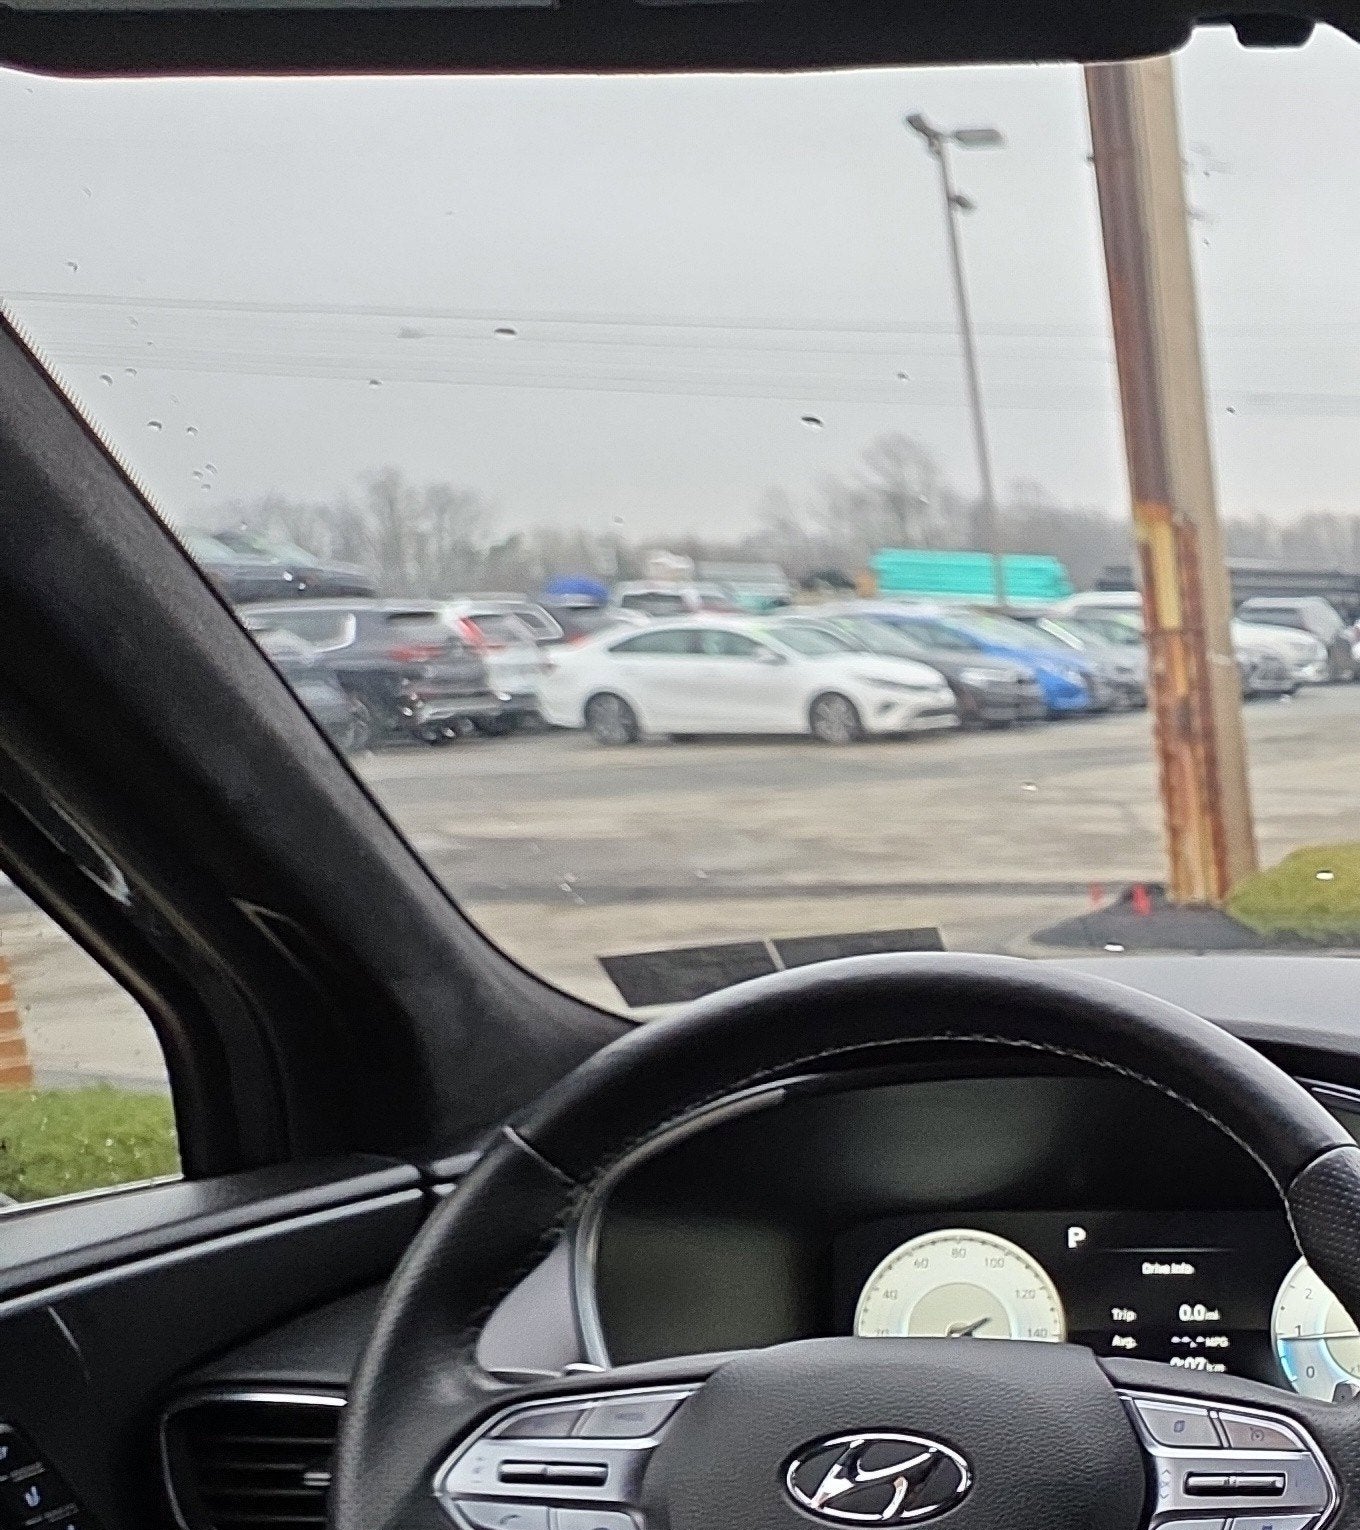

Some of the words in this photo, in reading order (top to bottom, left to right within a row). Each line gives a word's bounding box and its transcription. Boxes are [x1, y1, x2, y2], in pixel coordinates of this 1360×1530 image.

[1067, 1226, 1087, 1249] P
[985, 1257, 1005, 1269] 100
[883, 1289, 898, 1300] 40
[1015, 1289, 1036, 1300] 120
[1305, 1288, 1313, 1300] 2
[1027, 1328, 1048, 1338] 140
[1306, 1365, 1315, 1379] 0
